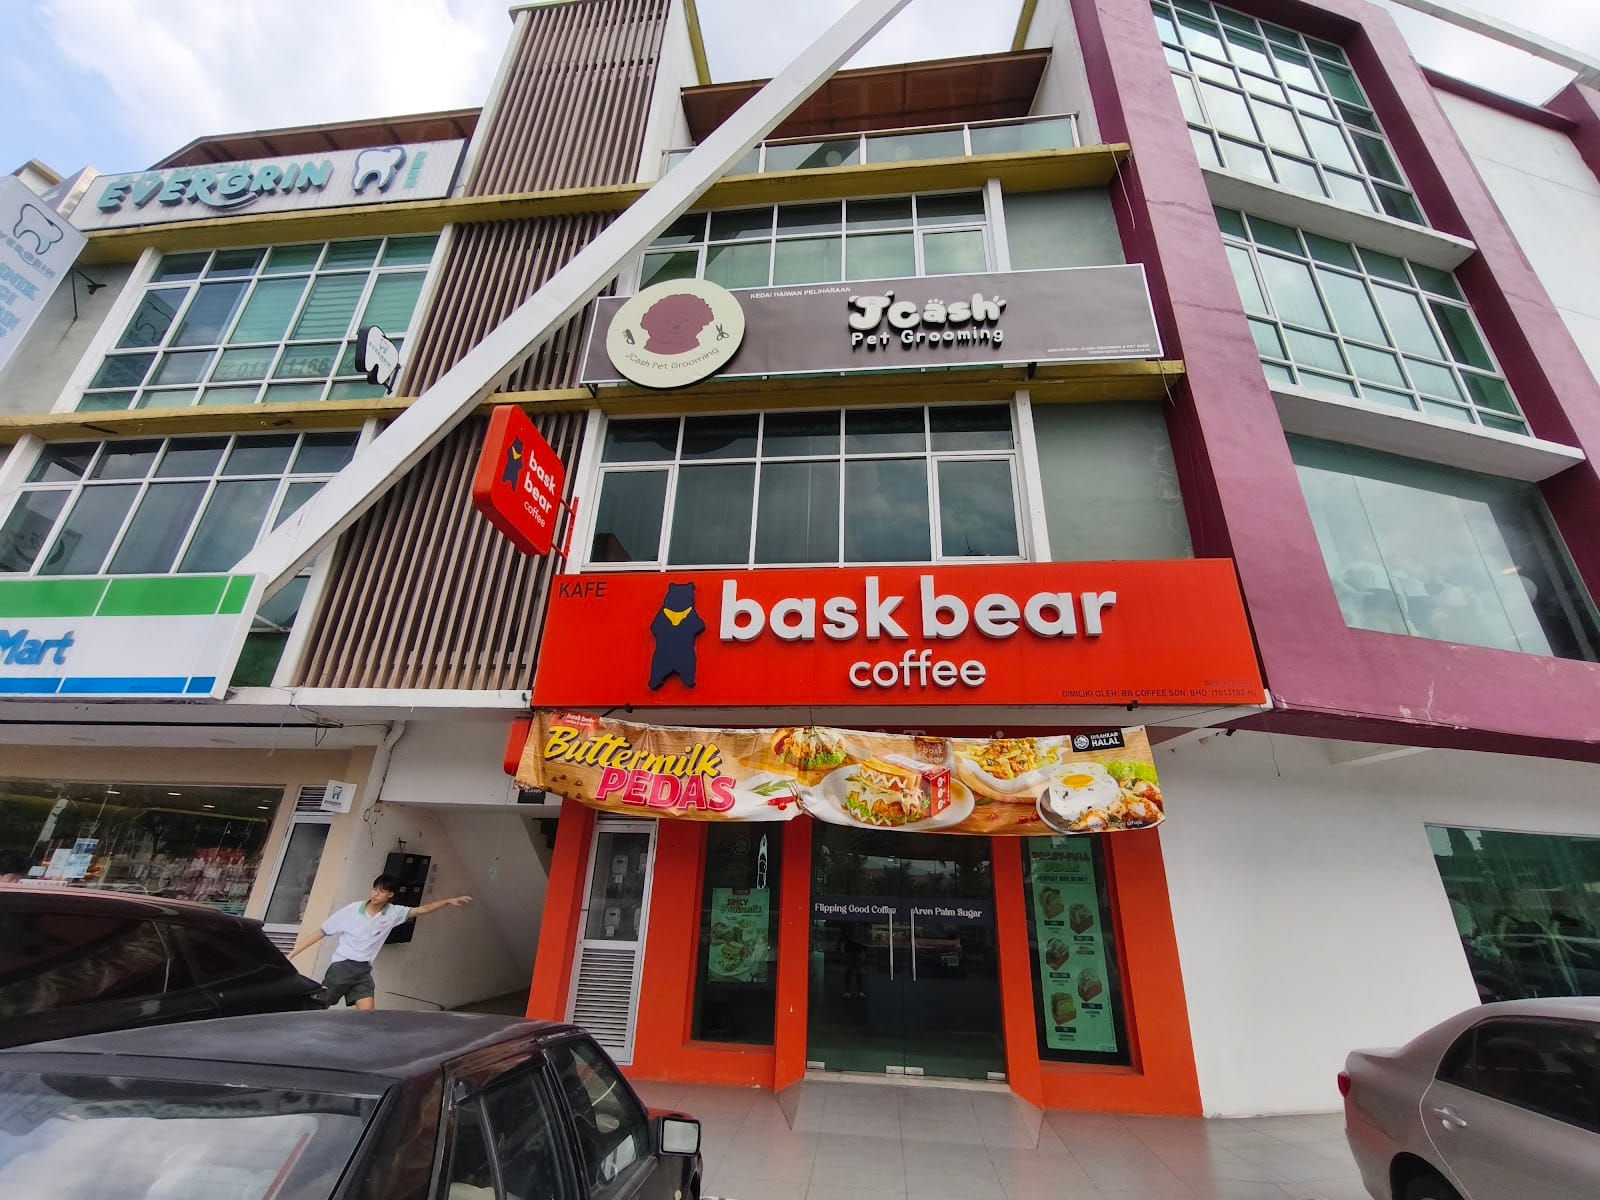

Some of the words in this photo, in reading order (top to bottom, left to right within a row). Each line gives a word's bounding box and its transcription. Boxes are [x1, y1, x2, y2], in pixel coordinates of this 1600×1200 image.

[97, 160, 334, 210] EVERGRIN
[750, 291, 773, 299] KEDAI
[773, 289, 803, 298] HAIWAN
[803, 286, 851, 296] PELIHARAAN
[851, 331, 891, 347] Pet
[901, 327, 1004, 346] Grooming
[651, 361, 669, 370] Pet
[671, 347, 720, 369] Grooming
[529, 450, 556, 496] bask
[524, 472, 553, 513] bear
[523, 501, 546, 528] coffee
[558, 581, 607, 598] KAFE
[719, 575, 910, 642] bask
[920, 575, 1117, 640] bear
[849, 649, 987, 688] coffee
[1062, 689, 1094, 698] DIMILIKI
[1121, 689, 1134, 697] BB
[1135, 688, 1168, 697] COFFEE
[544, 726, 722, 778] Buttermilk
[1091, 736, 1121, 748] HALAL
[595, 765, 737, 811] PEDAS
[814, 903, 847, 914] Flipping
[848, 904, 870, 914] Good
[934, 906, 956, 916] Palm
[957, 907, 983, 919] Sugar
